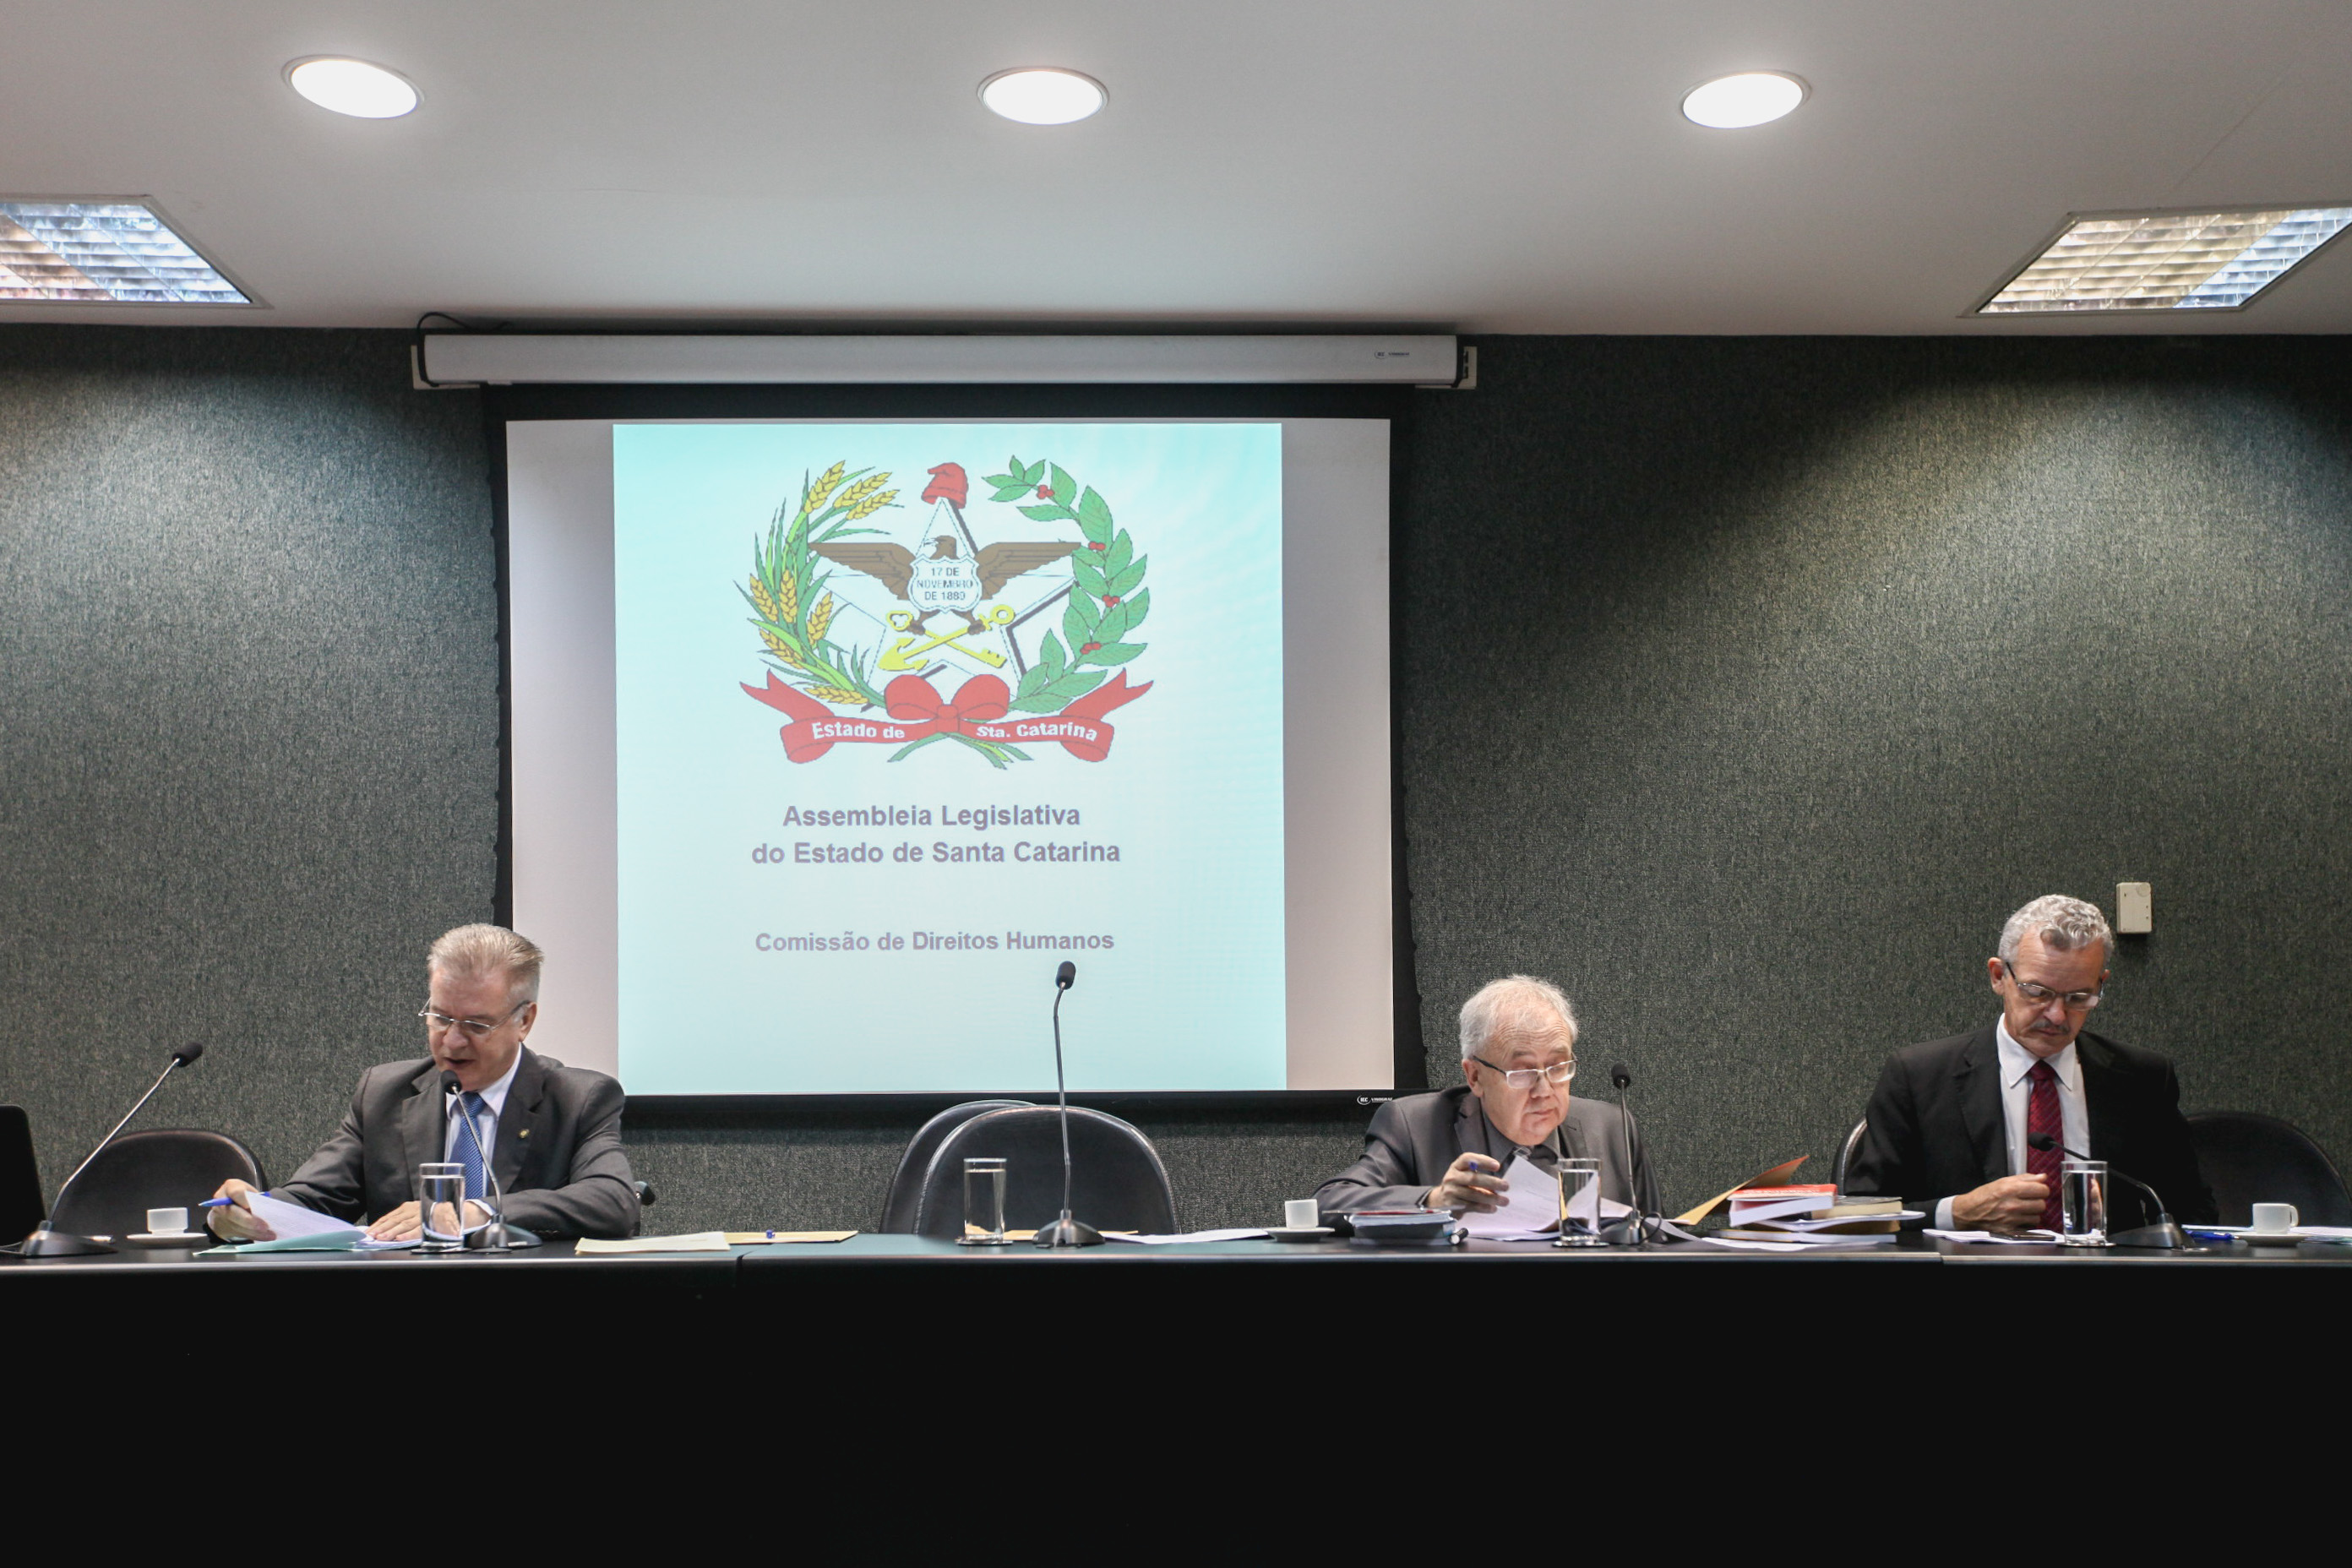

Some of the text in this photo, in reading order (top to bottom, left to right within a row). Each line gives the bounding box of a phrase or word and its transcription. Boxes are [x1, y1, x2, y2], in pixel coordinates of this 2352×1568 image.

[931, 567, 960, 577] 17 DE
[917, 579, 973, 589] NOVEMBRO
[924, 591, 937, 601] DE
[812, 721, 905, 739] Estado de
[977, 721, 1097, 742] Sta. Catarina
[782, 804, 1081, 830] Assembleia Legislativa
[752, 841, 1120, 863] do Estado de Santa Catarina
[755, 931, 1114, 951] Comissão de Direitos Humanos
